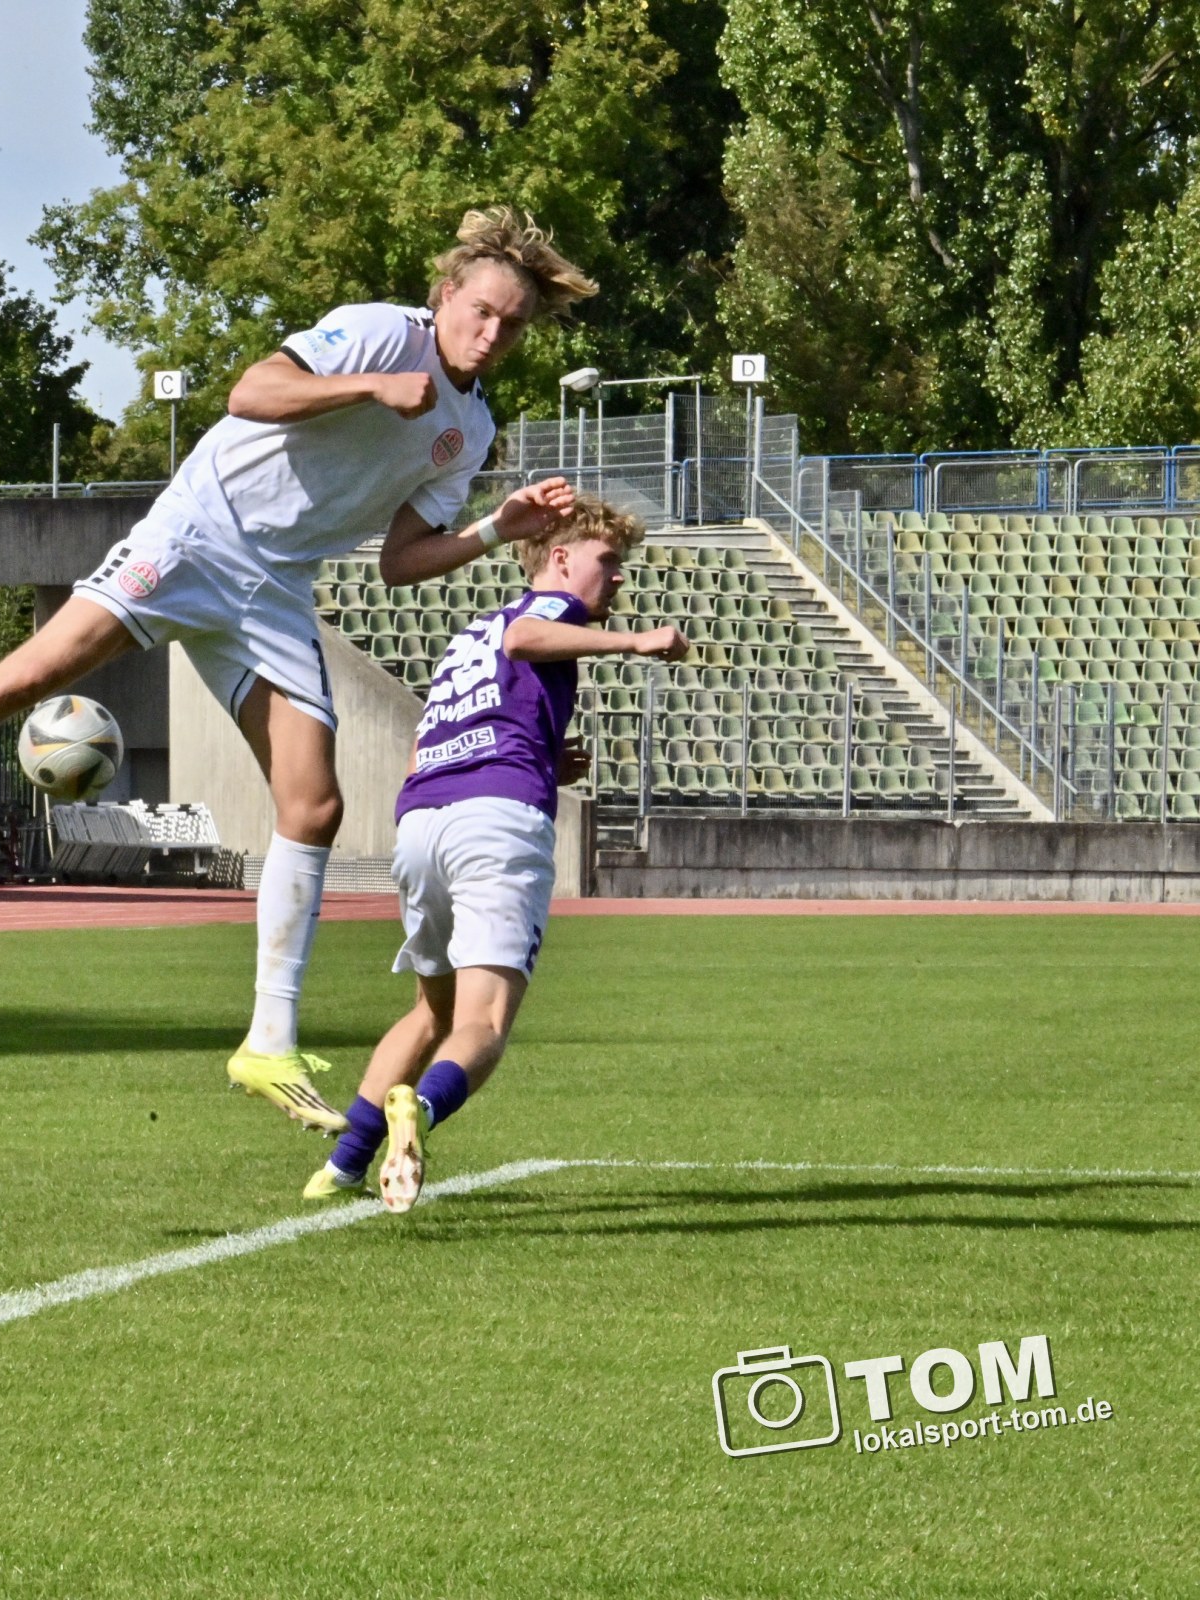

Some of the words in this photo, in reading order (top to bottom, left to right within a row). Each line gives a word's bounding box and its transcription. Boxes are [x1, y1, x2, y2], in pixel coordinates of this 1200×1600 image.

[742, 359, 756, 377] D
[161, 375, 173, 395] C
[448, 729, 492, 755] PLUS
